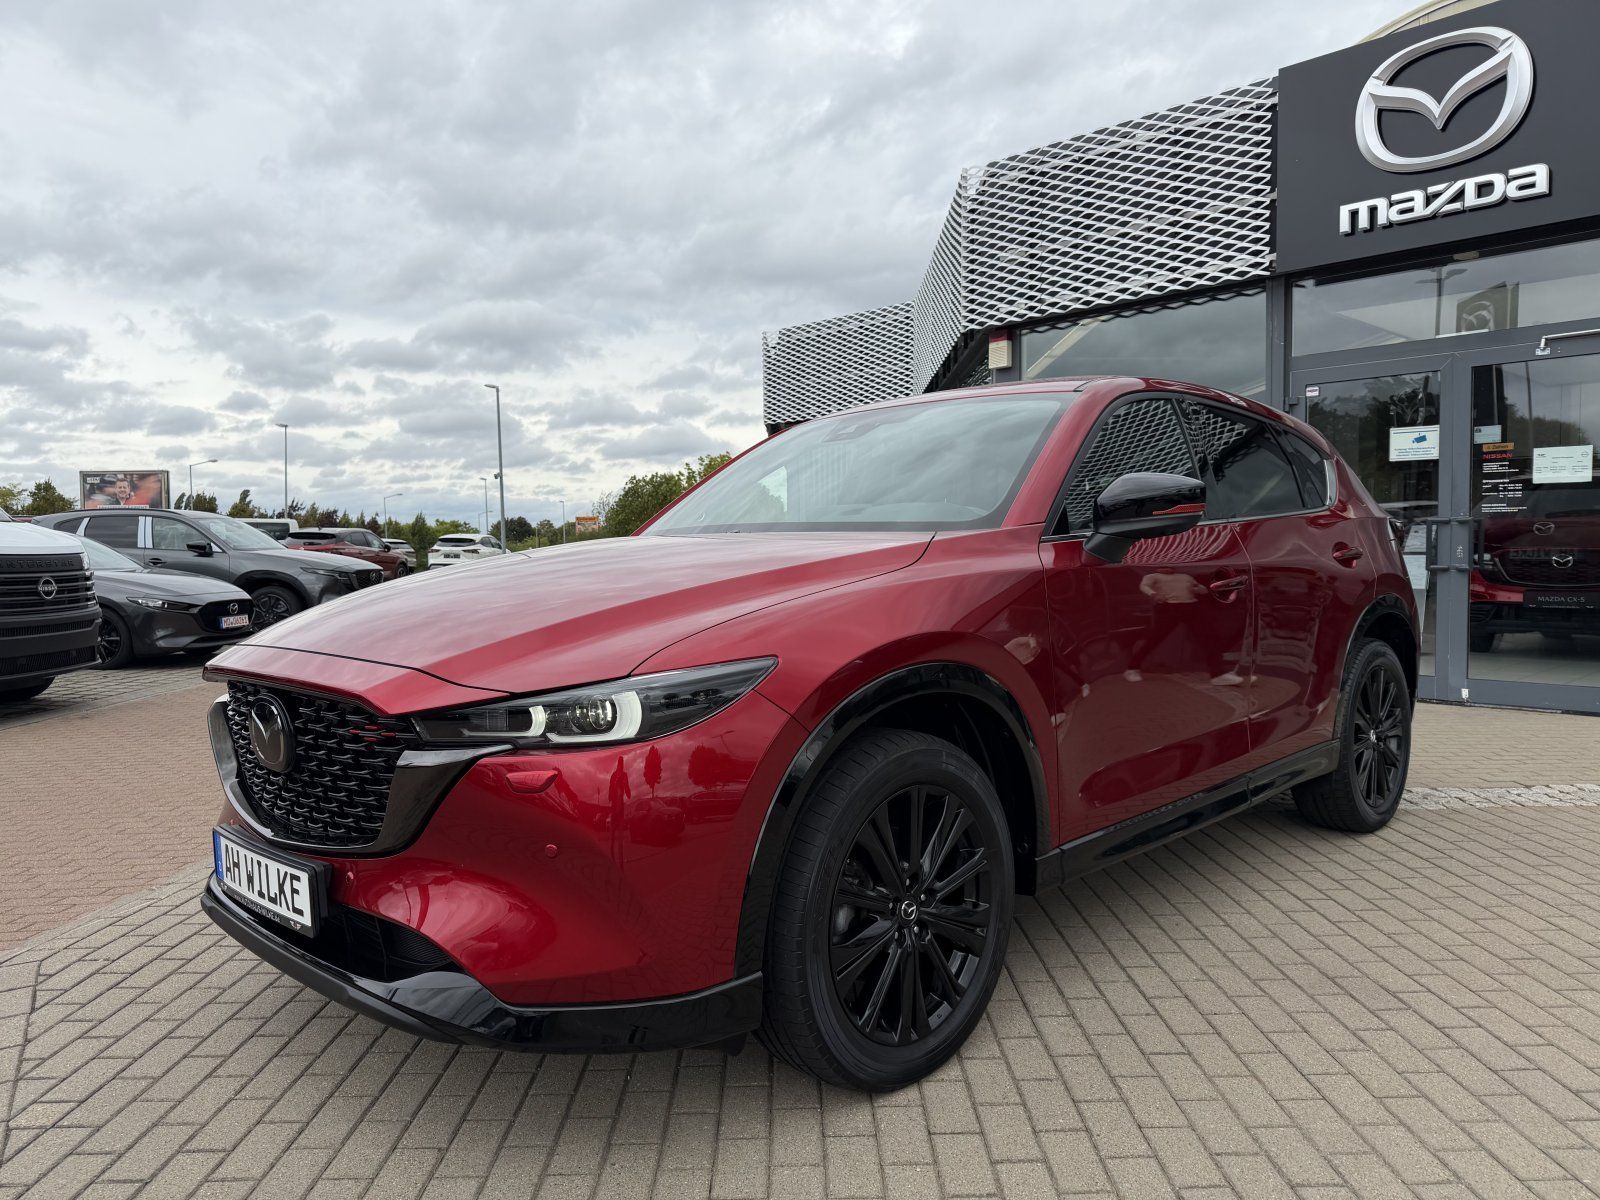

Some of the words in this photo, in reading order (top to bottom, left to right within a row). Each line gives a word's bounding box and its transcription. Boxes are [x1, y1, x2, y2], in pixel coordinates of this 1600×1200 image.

[1339, 163, 1550, 235] mazda
[1537, 595, 1566, 603] MAZDA
[1567, 595, 1586, 603] CX-5
[224, 843, 242, 887] AH
[244, 853, 305, 918] WILKE
